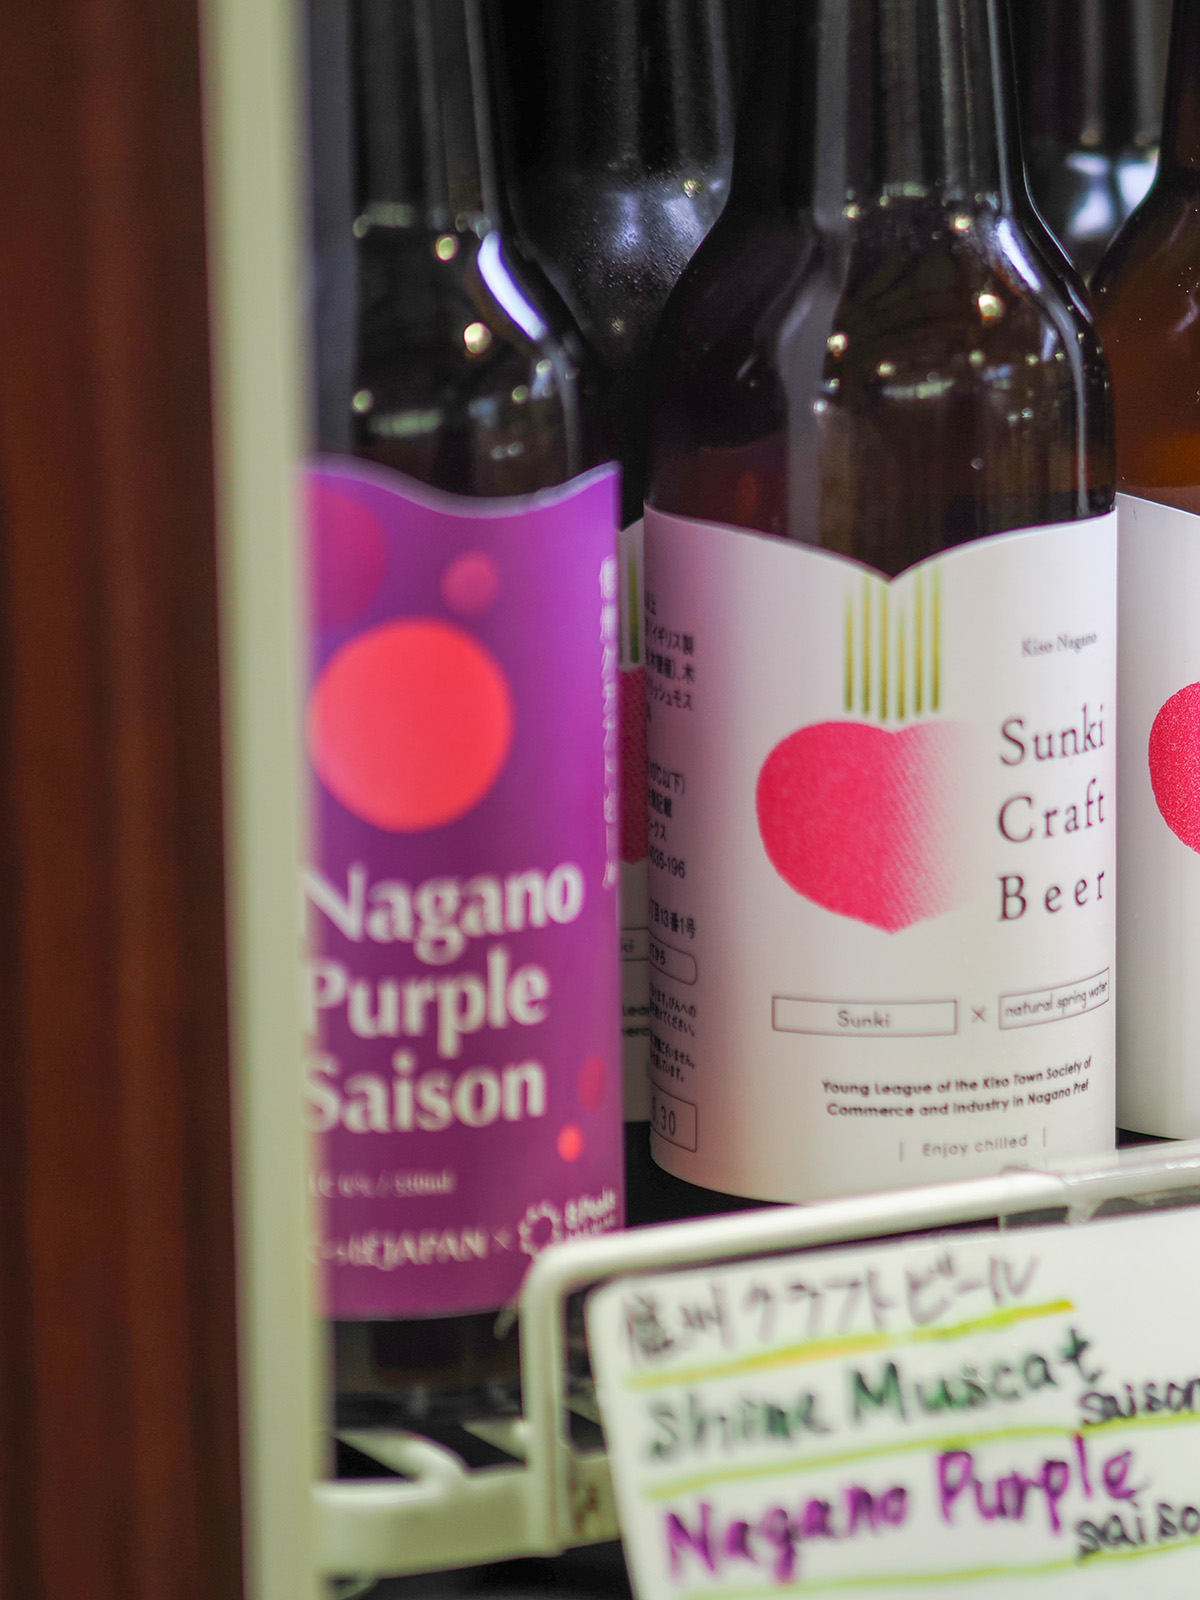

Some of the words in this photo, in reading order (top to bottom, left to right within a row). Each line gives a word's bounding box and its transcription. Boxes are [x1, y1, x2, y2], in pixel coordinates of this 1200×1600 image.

[1021, 638, 1054, 657] Kiso
[1057, 631, 1099, 655] Nagano
[999, 702, 1106, 767] Sunki
[997, 777, 1106, 843] Craft
[301, 861, 585, 965] Nagano
[997, 870, 1106, 922] Beer
[305, 946, 550, 1059] Purple
[837, 1008, 892, 1029] Sunki
[1005, 992, 1053, 1017] natural
[1056, 990, 1087, 1015] spring
[303, 1047, 548, 1135] Saison
[822, 1080, 870, 1098] Young
[875, 1082, 932, 1097] League
[937, 1080, 952, 1095] of
[955, 1079, 978, 1092] the
[982, 1077, 1010, 1091] Kiso
[1013, 1072, 1043, 1086] Town
[1046, 1064, 1082, 1081] Society
[1083, 1056, 1092, 1070] of
[826, 1102, 915, 1117] Commerce
[919, 1103, 949, 1117] and
[953, 1098, 1009, 1114] Industry
[1013, 1095, 1024, 1108] in
[1028, 1089, 1071, 1106] Nagano
[1073, 1078, 1090, 1097] Pref
[922, 1142, 969, 1158] Enjoy
[974, 1134, 1029, 1154] chilled
[643, 1390, 834, 1463] Shine
[846, 1327, 1100, 1425] Muscat
[664, 1482, 909, 1585] Nagano
[936, 1430, 1142, 1536] Purple
